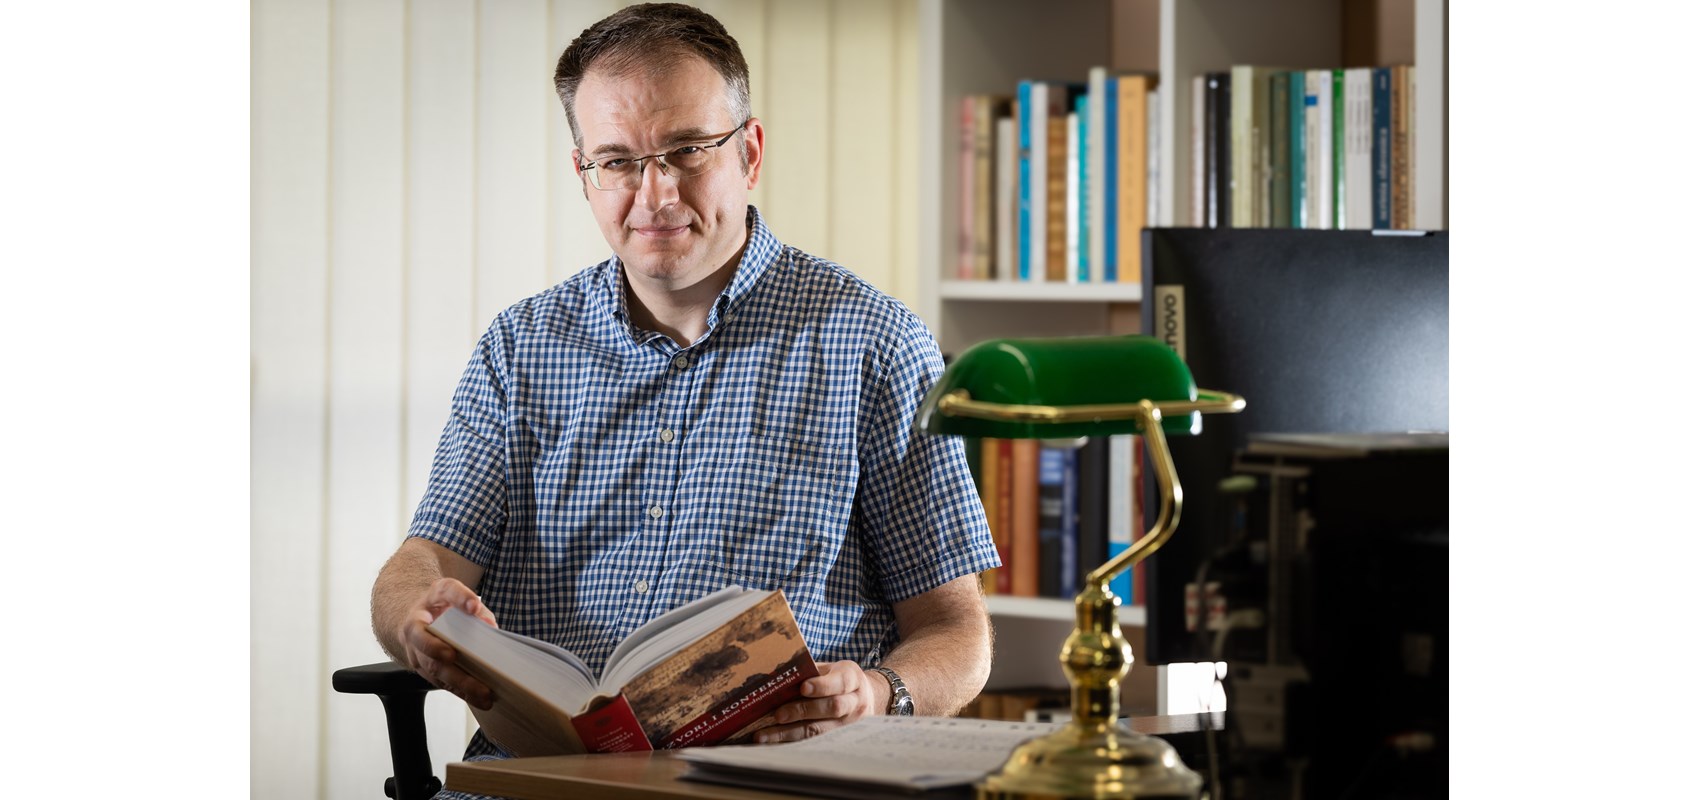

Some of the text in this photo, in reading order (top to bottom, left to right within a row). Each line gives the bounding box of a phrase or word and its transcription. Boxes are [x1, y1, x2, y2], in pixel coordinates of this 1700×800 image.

[1164, 293, 1178, 348] novo
[700, 709, 740, 737] jadranskom
[741, 675, 796, 714] srednjovjekovlju
[721, 666, 798, 715] KONTEKSTI
